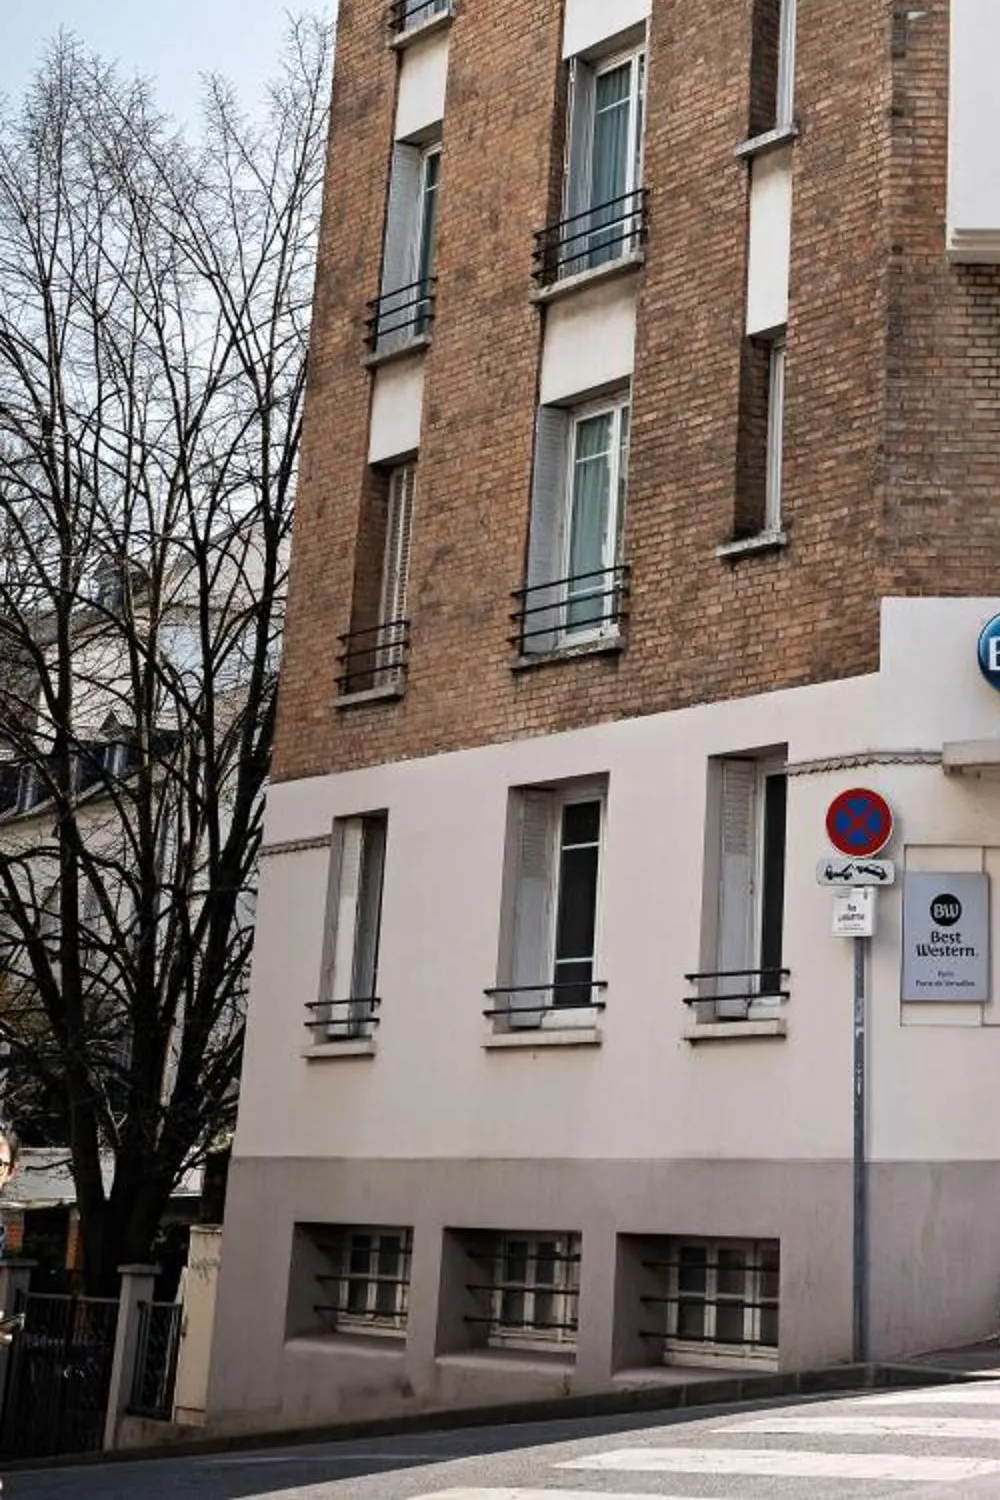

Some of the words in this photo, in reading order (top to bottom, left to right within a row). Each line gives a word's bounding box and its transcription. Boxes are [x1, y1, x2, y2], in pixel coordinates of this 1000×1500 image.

[932, 902, 960, 918] BW
[930, 931, 962, 945] Best
[916, 944, 976, 957] Western
